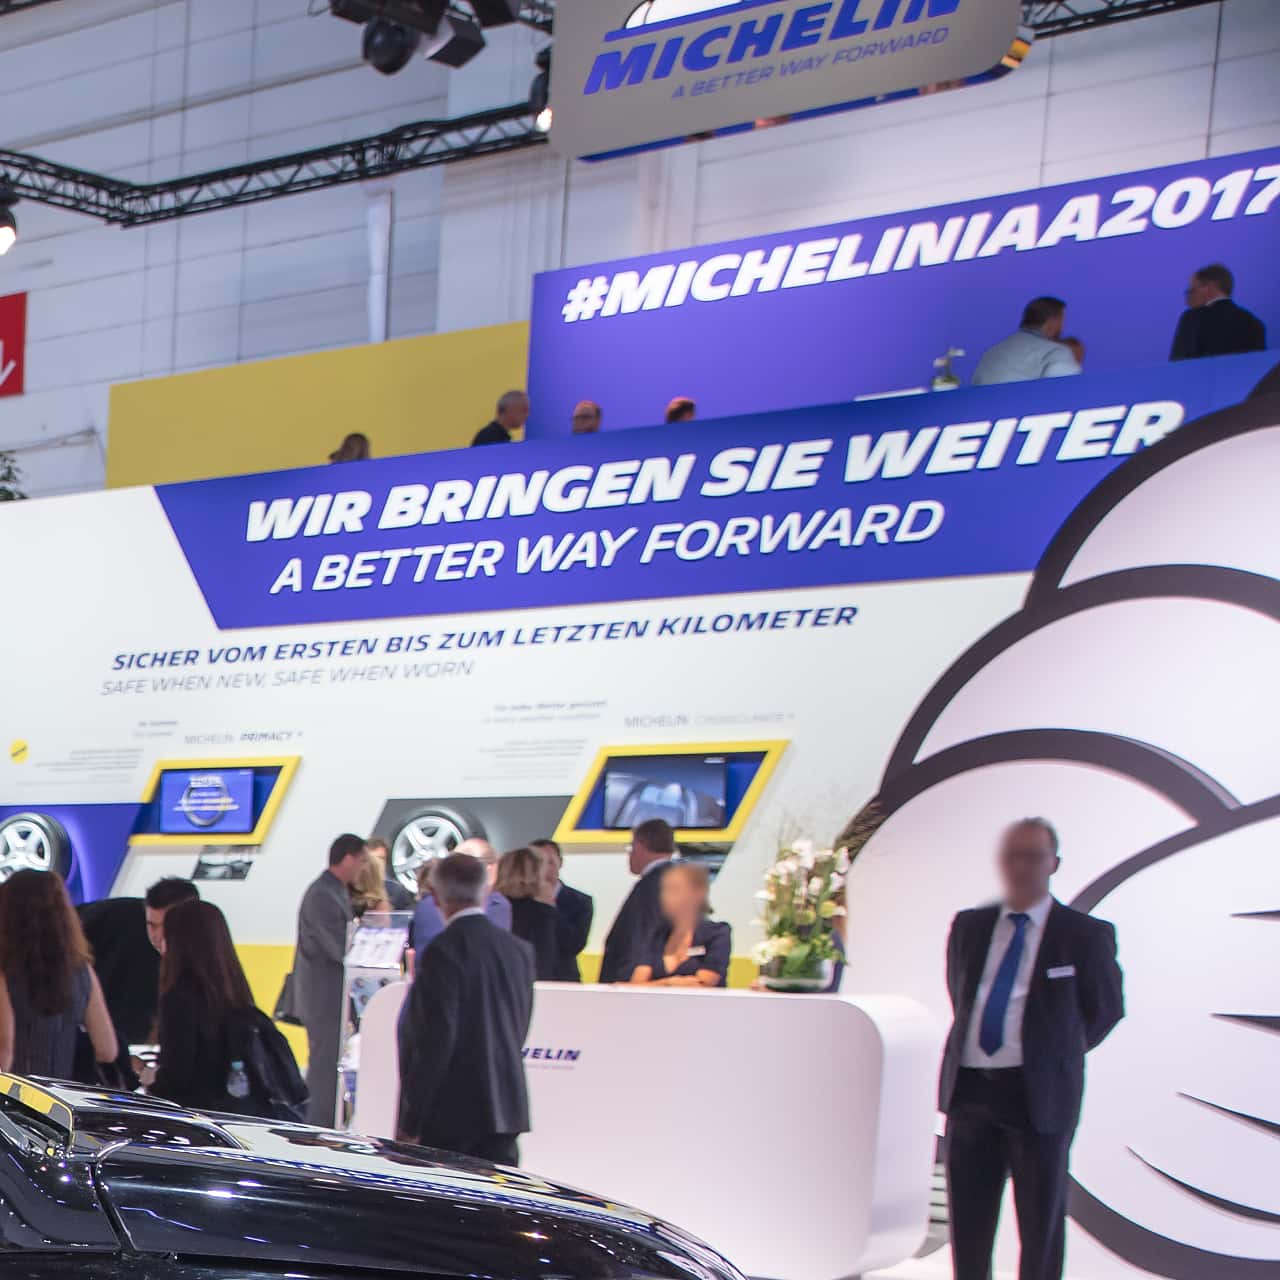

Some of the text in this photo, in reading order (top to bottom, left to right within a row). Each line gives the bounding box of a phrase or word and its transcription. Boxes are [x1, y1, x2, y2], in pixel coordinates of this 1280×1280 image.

[671, 27, 950, 99] A BETTER WAY FORWARD
[561, 163, 1280, 323] #MICHELINIAA2017
[245, 400, 1186, 544] WIR BRINGEN SIE WEITER
[268, 499, 945, 595] A BETTER WAY FORWARD
[100, 679, 146, 697] SAFE
[152, 675, 213, 692] WHEN
[272, 668, 322, 687] SAFE
[329, 664, 398, 683] WHEN
[402, 659, 475, 680] WORN
[111, 606, 859, 672] SICHER VOM ERSTEN BIS ZUM LETZTEN KILOMETER
